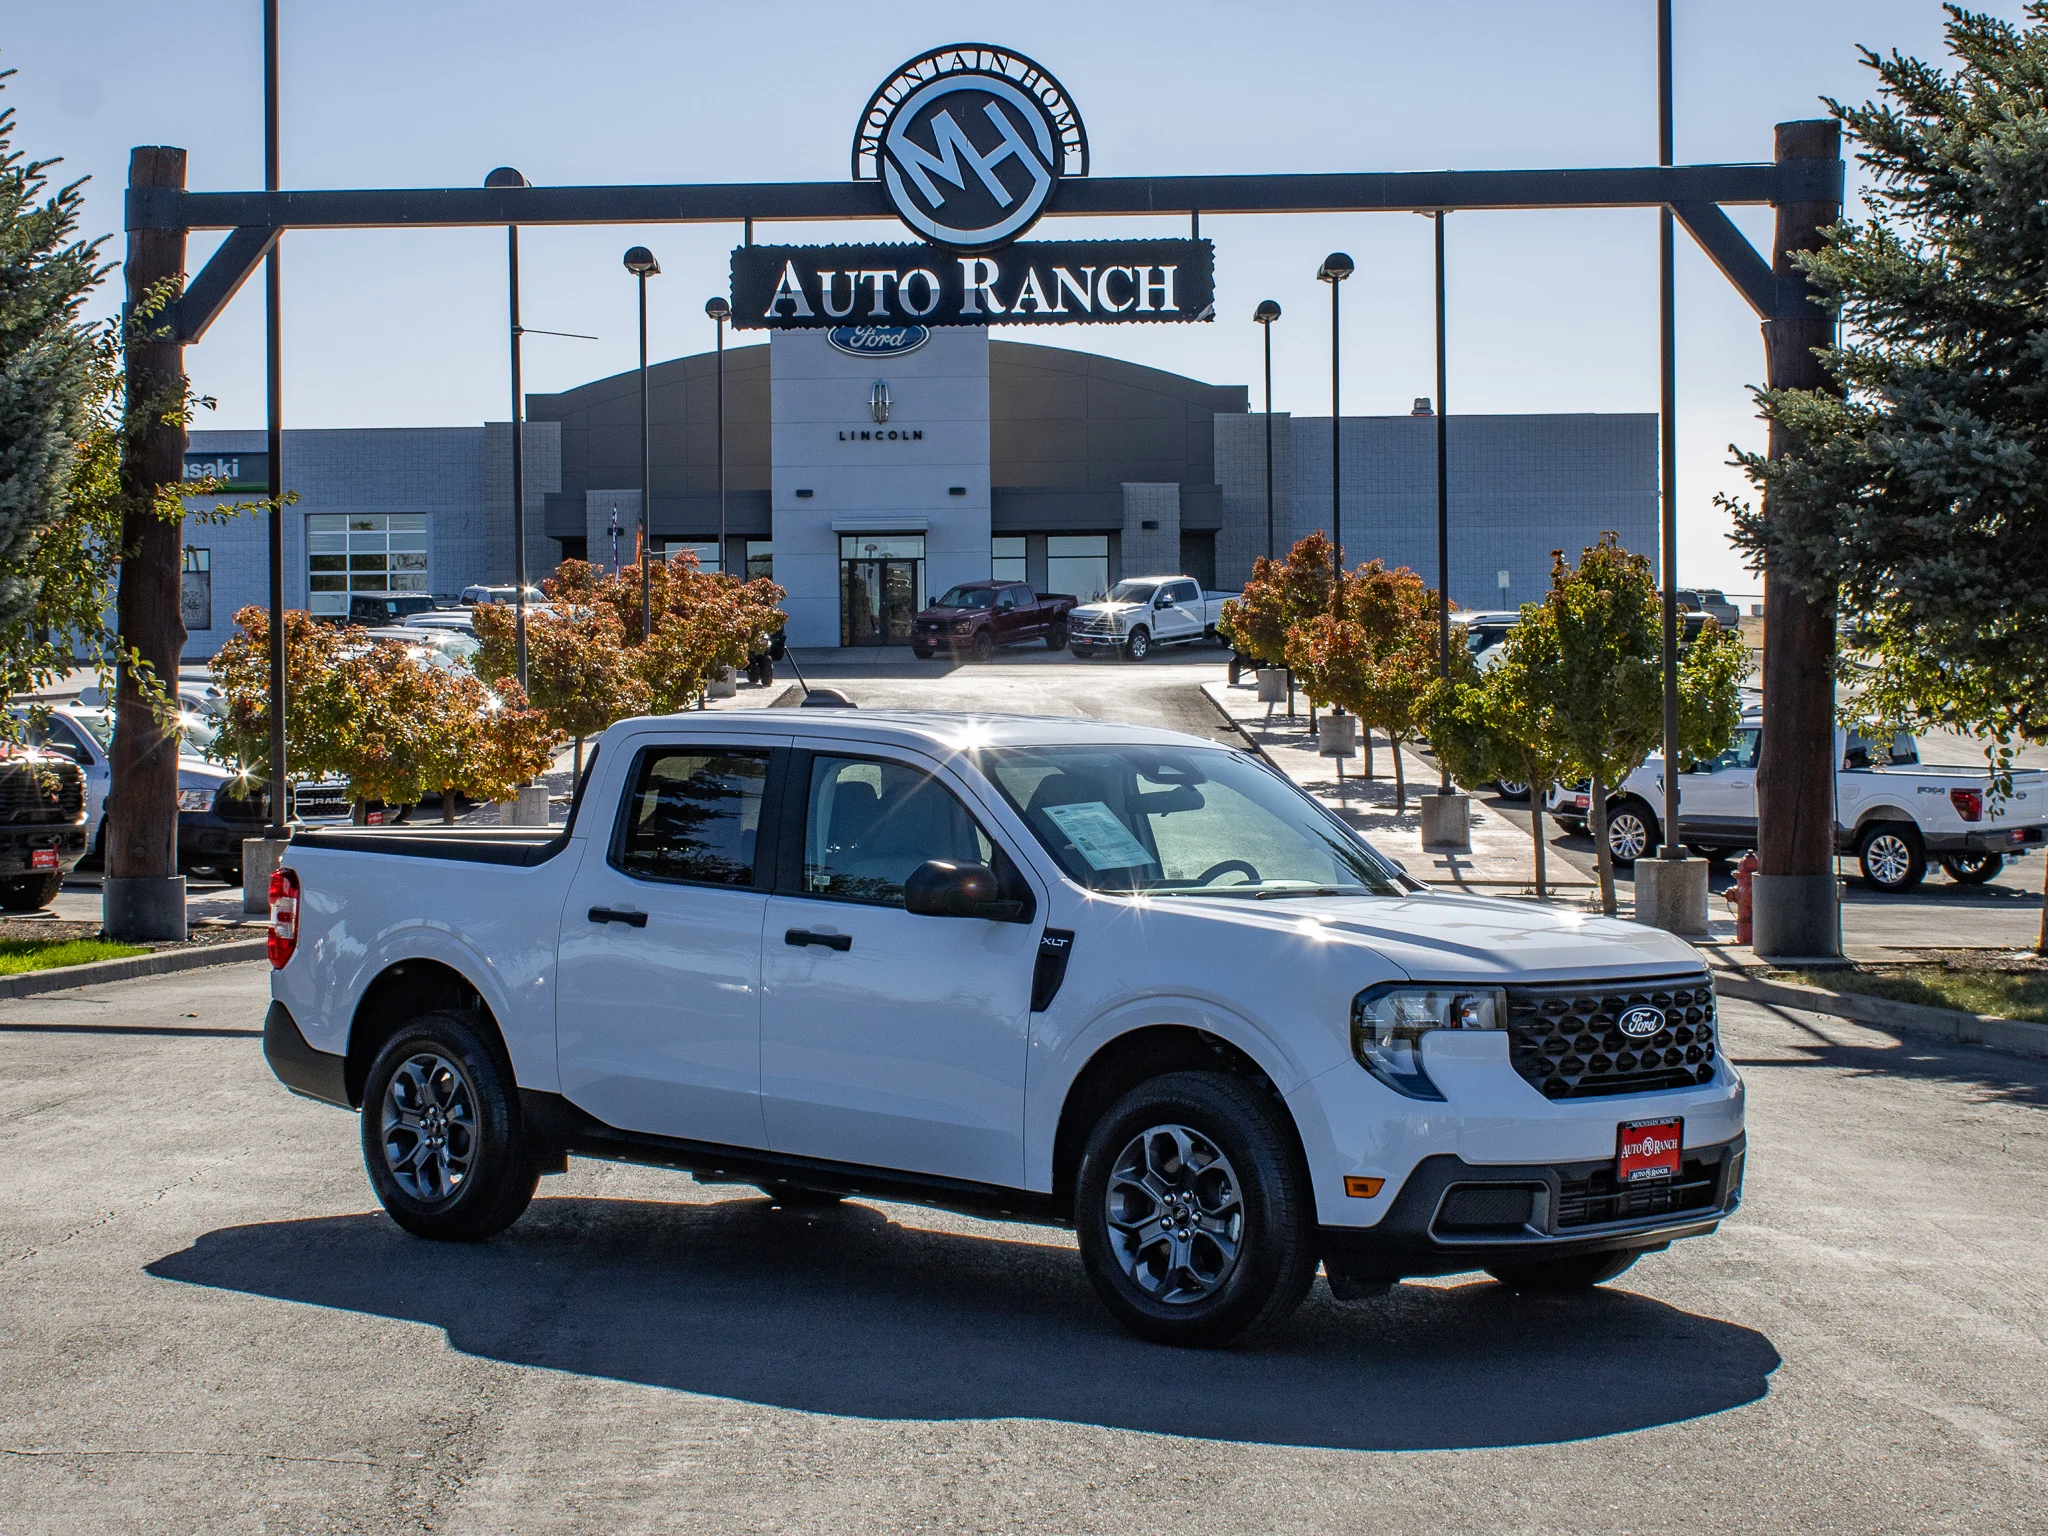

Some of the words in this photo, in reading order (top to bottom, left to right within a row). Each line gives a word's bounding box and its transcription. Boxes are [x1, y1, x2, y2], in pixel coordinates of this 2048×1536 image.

[859, 50, 1010, 158] MOUNTAIN
[1020, 67, 1083, 157] HOME
[764, 259, 941, 318] AUTO
[957, 257, 1180, 315] RANCH
[849, 324, 907, 348] Ford
[839, 430, 922, 441] LINCOLN
[1041, 936, 1069, 947] XLT
[1628, 1011, 1658, 1033] Ford
[1621, 1144, 1642, 1159] AUTO
[1653, 1139, 1678, 1155] RANCH
[1651, 1168, 1668, 1177] RANCH
